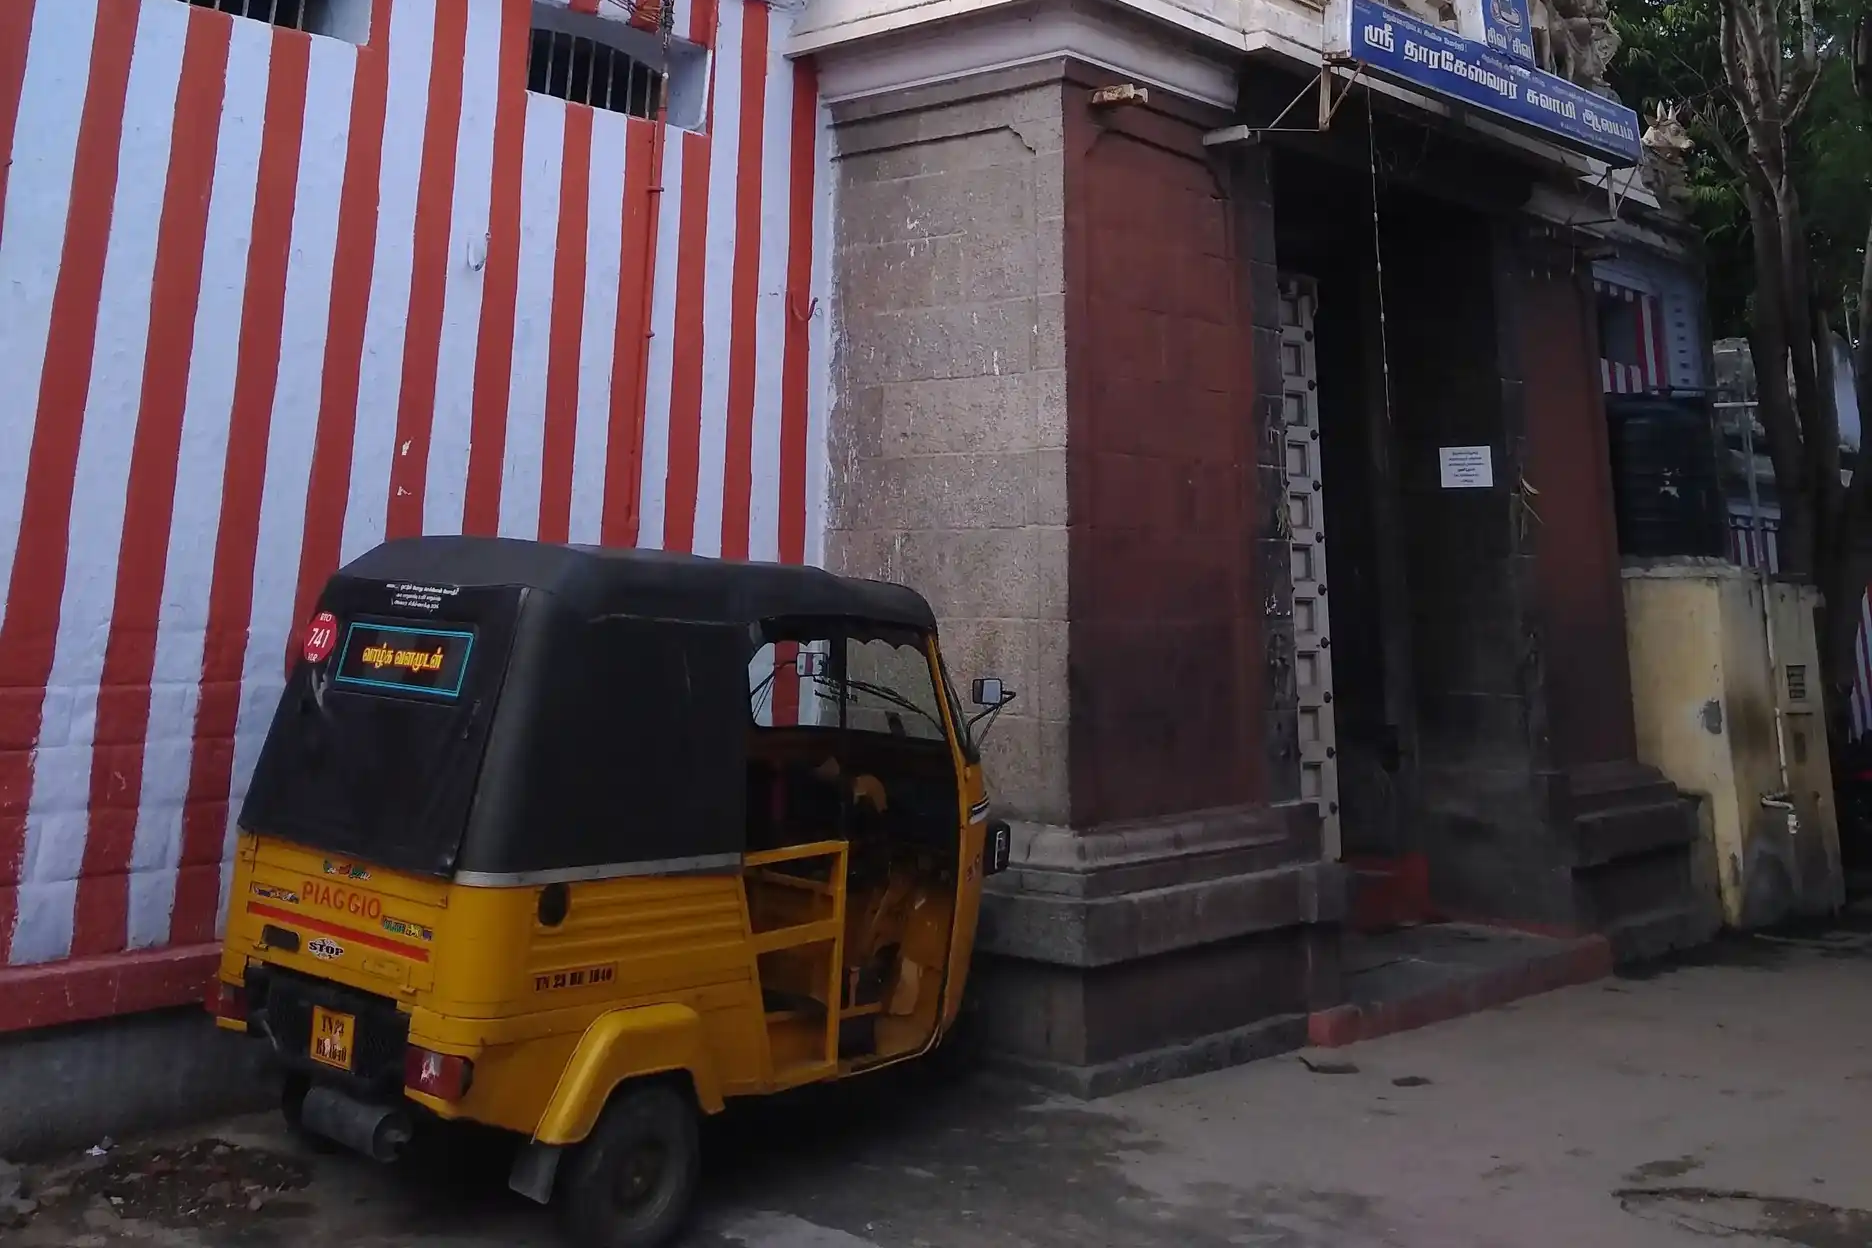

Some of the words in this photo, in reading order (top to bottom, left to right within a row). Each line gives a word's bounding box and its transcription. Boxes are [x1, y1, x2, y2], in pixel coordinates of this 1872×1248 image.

[1487, 27, 1508, 50] சிவ
[1403, 39, 1518, 100] தாரகேஸ்வரர்
[1526, 88, 1576, 120] சுவாமி
[1582, 108, 1634, 141] ஆலயம்
[307, 627, 331, 649] 741
[362, 641, 394, 669] வாழ்க
[394, 646, 444, 672] வளமுடன்
[302, 880, 382, 920] PIAGGIO
[308, 940, 344, 957] STOP
